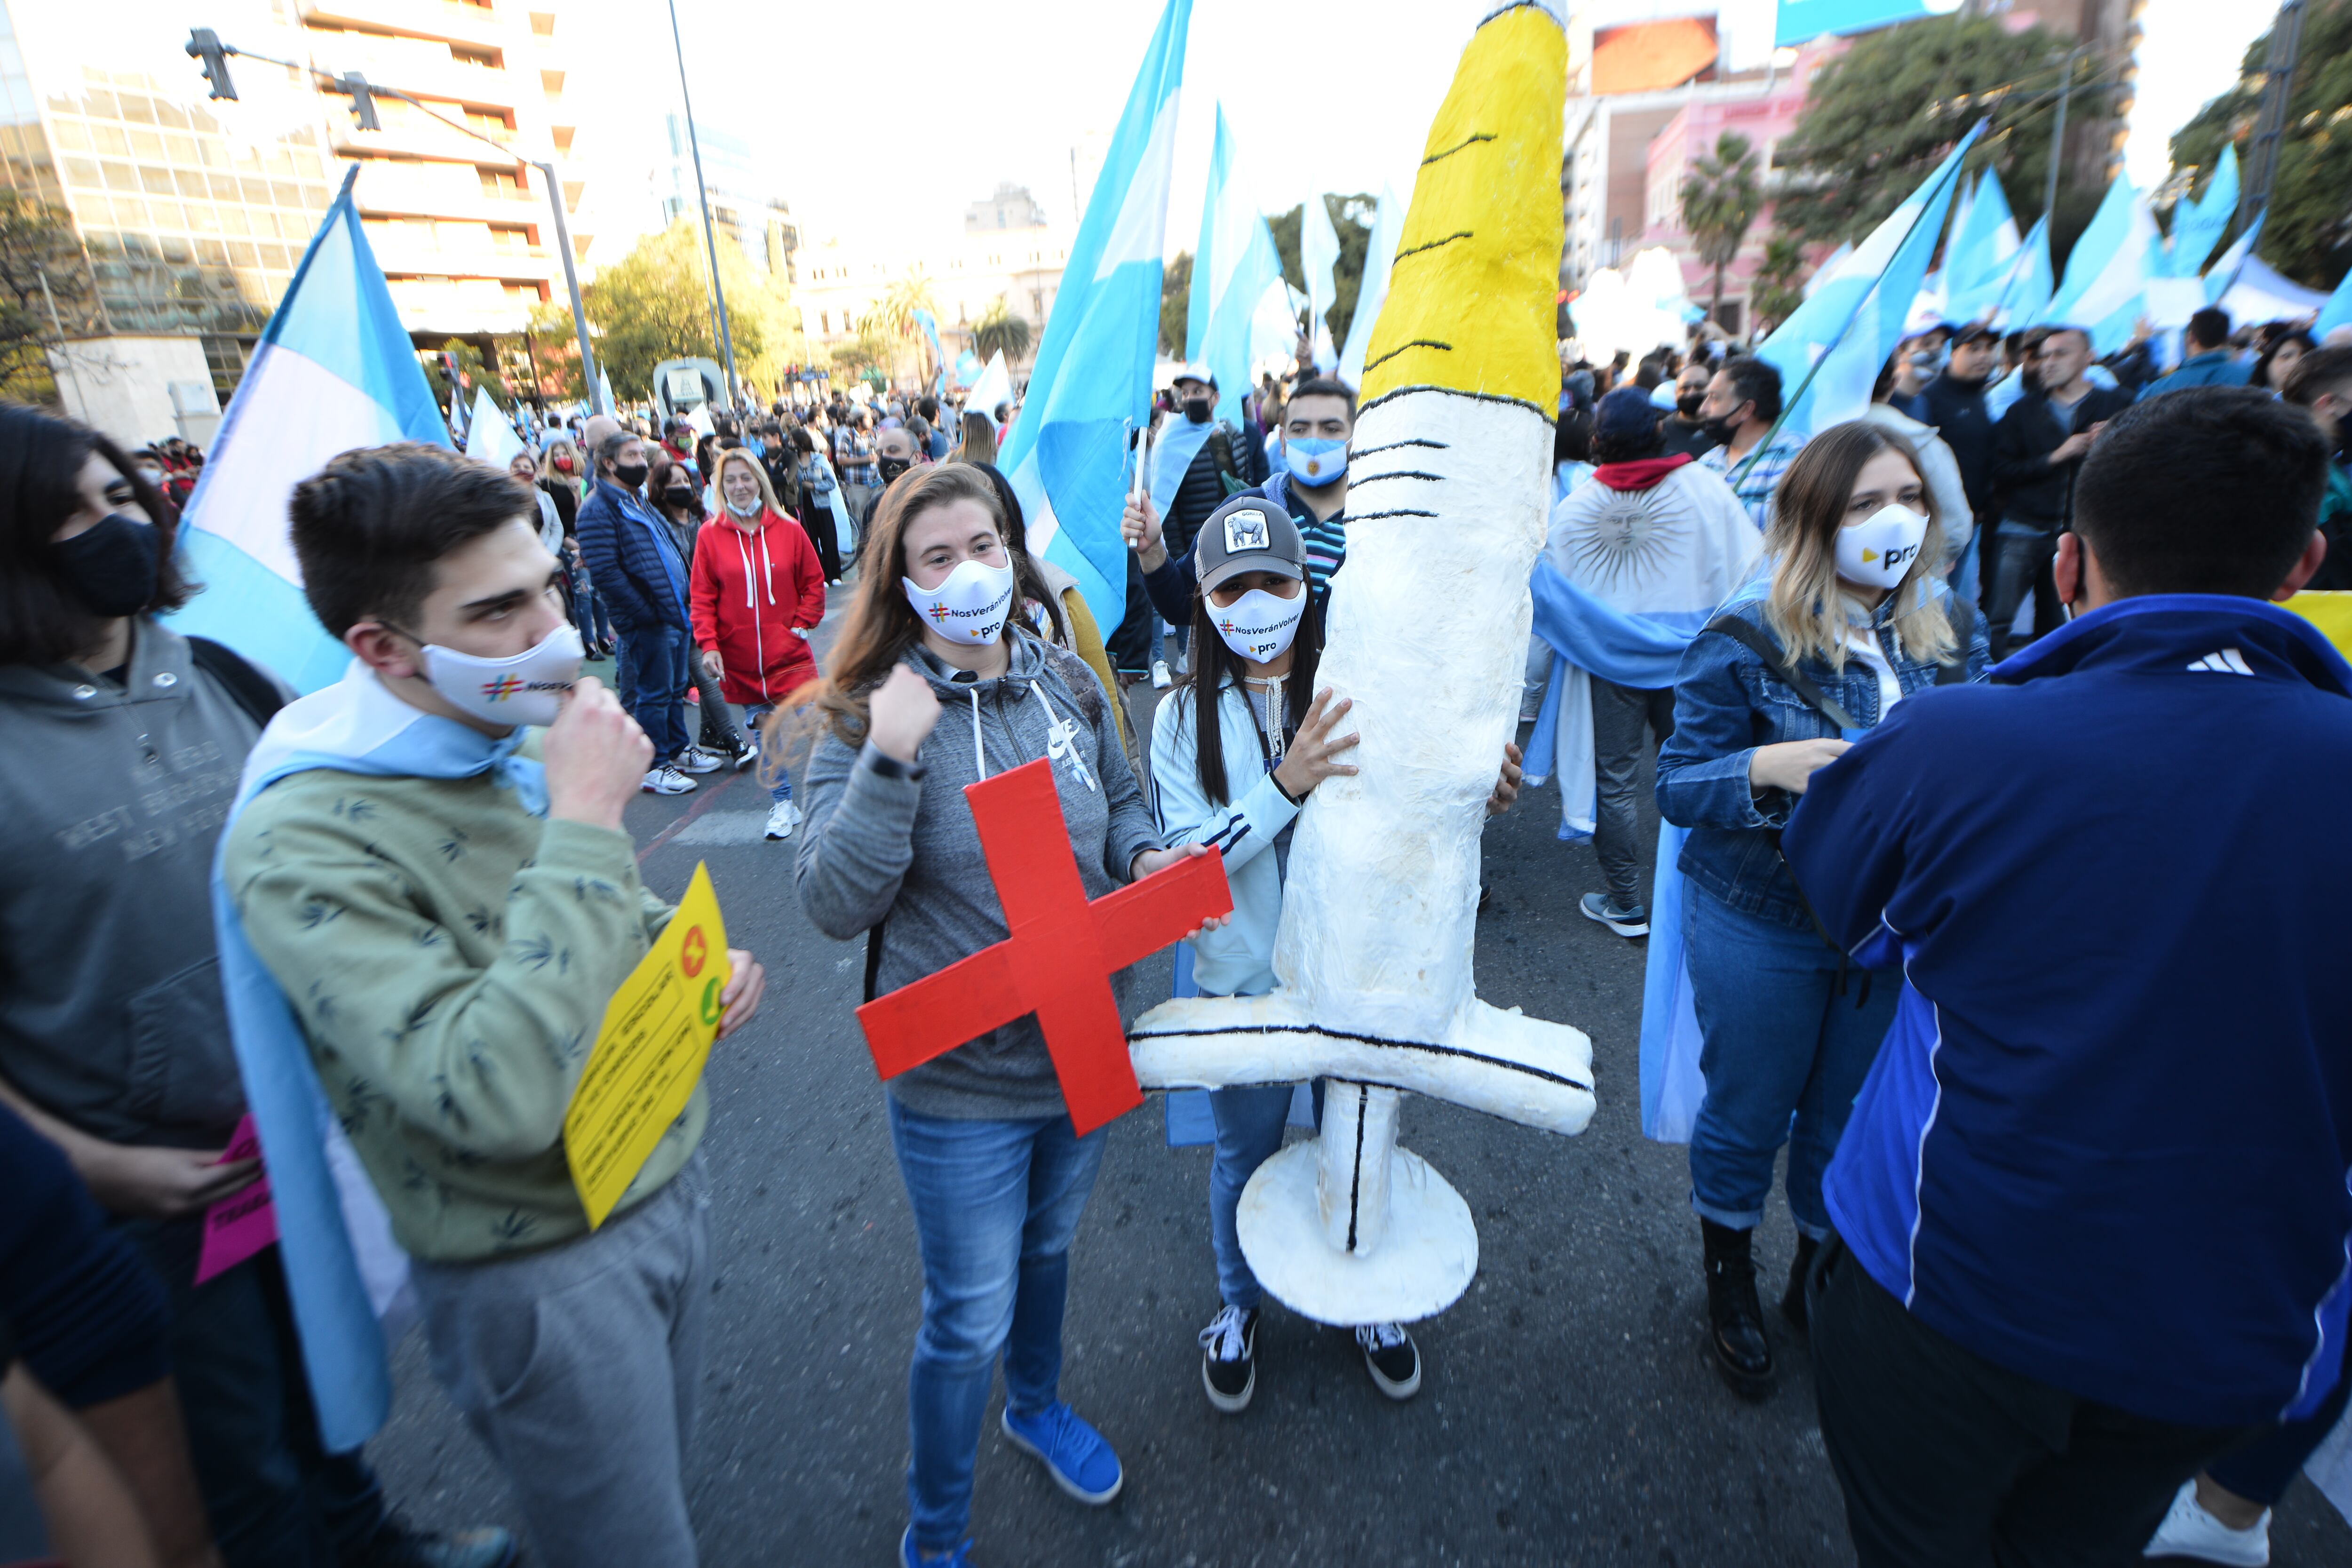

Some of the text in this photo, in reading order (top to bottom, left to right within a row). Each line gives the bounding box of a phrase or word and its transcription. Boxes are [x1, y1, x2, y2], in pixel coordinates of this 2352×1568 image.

[1884, 543, 1917, 570] pro
[981, 622, 1000, 638] pro
[1220, 613, 1299, 637] #NosVeránVolver
[1258, 643, 1276, 655] pro
[1061, 756, 1073, 769] JUS
